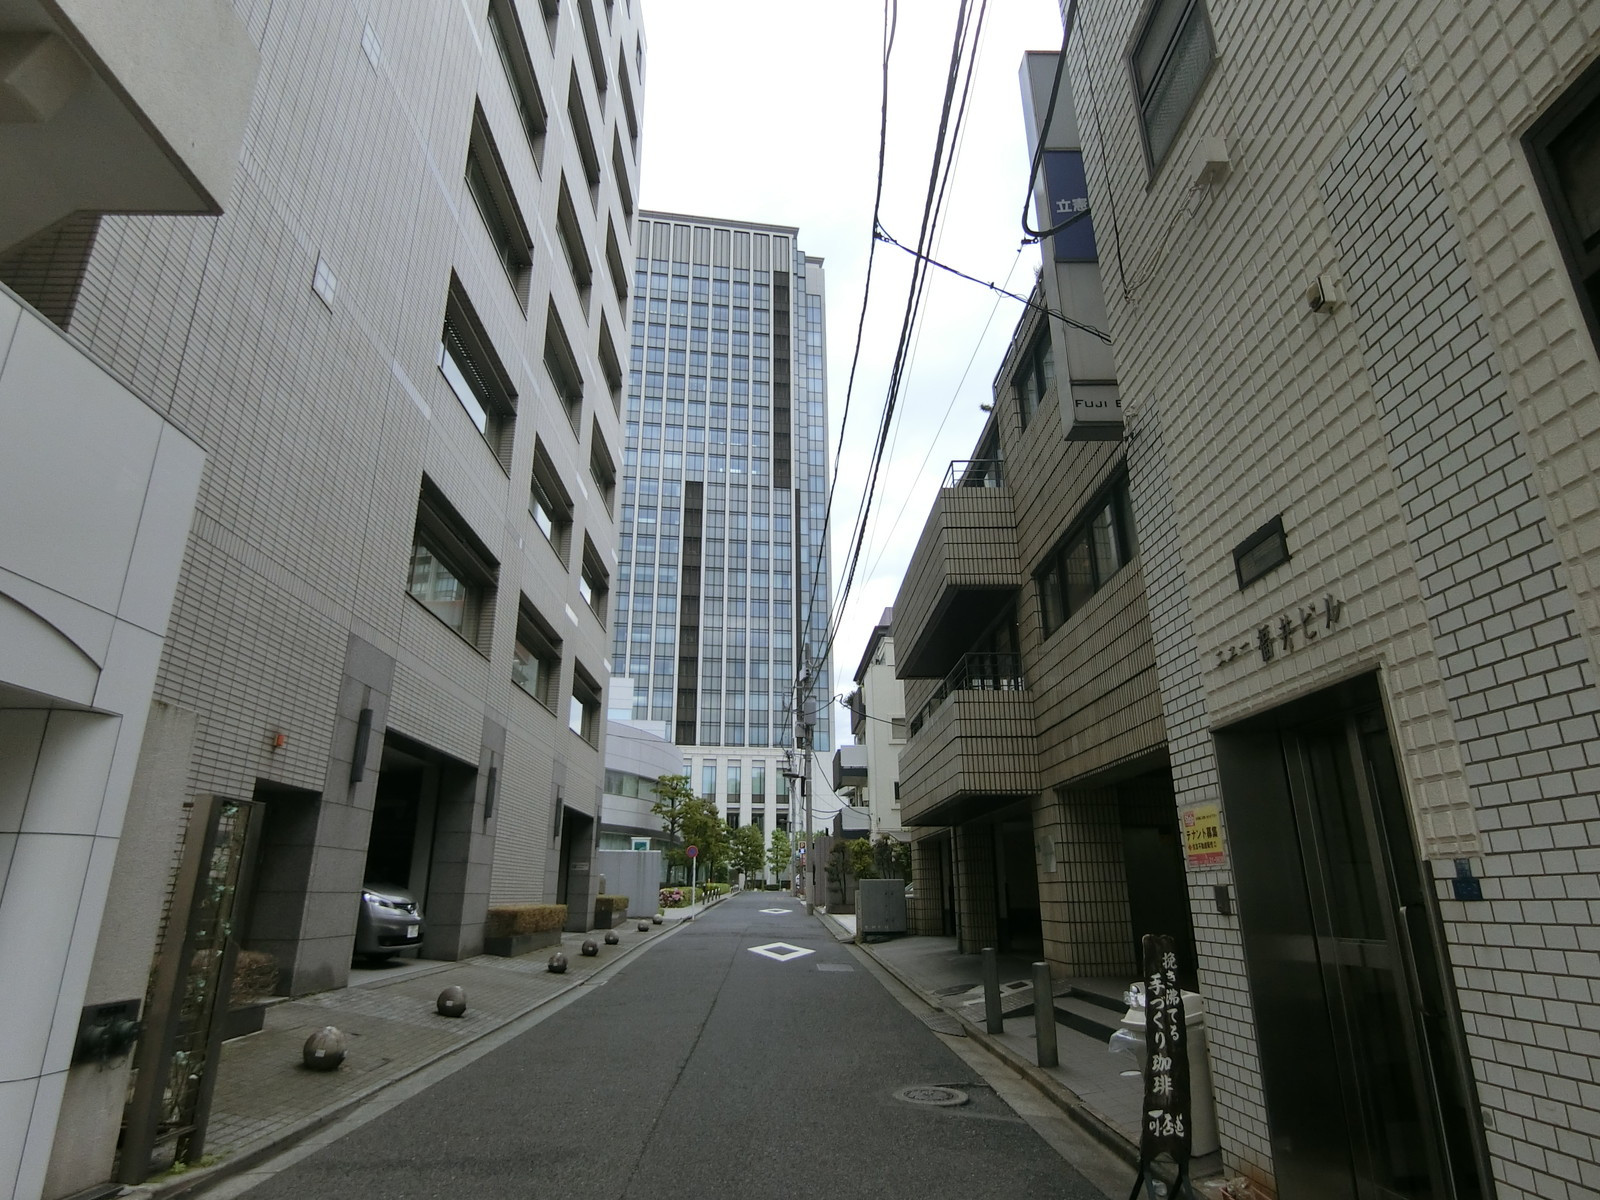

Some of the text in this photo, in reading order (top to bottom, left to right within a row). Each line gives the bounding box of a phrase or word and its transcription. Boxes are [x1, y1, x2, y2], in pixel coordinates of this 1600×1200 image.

[1056, 198, 1087, 213] 立憲
[1075, 399, 1108, 408] FUJI
[1186, 826, 1218, 841] テナント募集
[1147, 972, 1174, 1096] 手づくり珈琲
